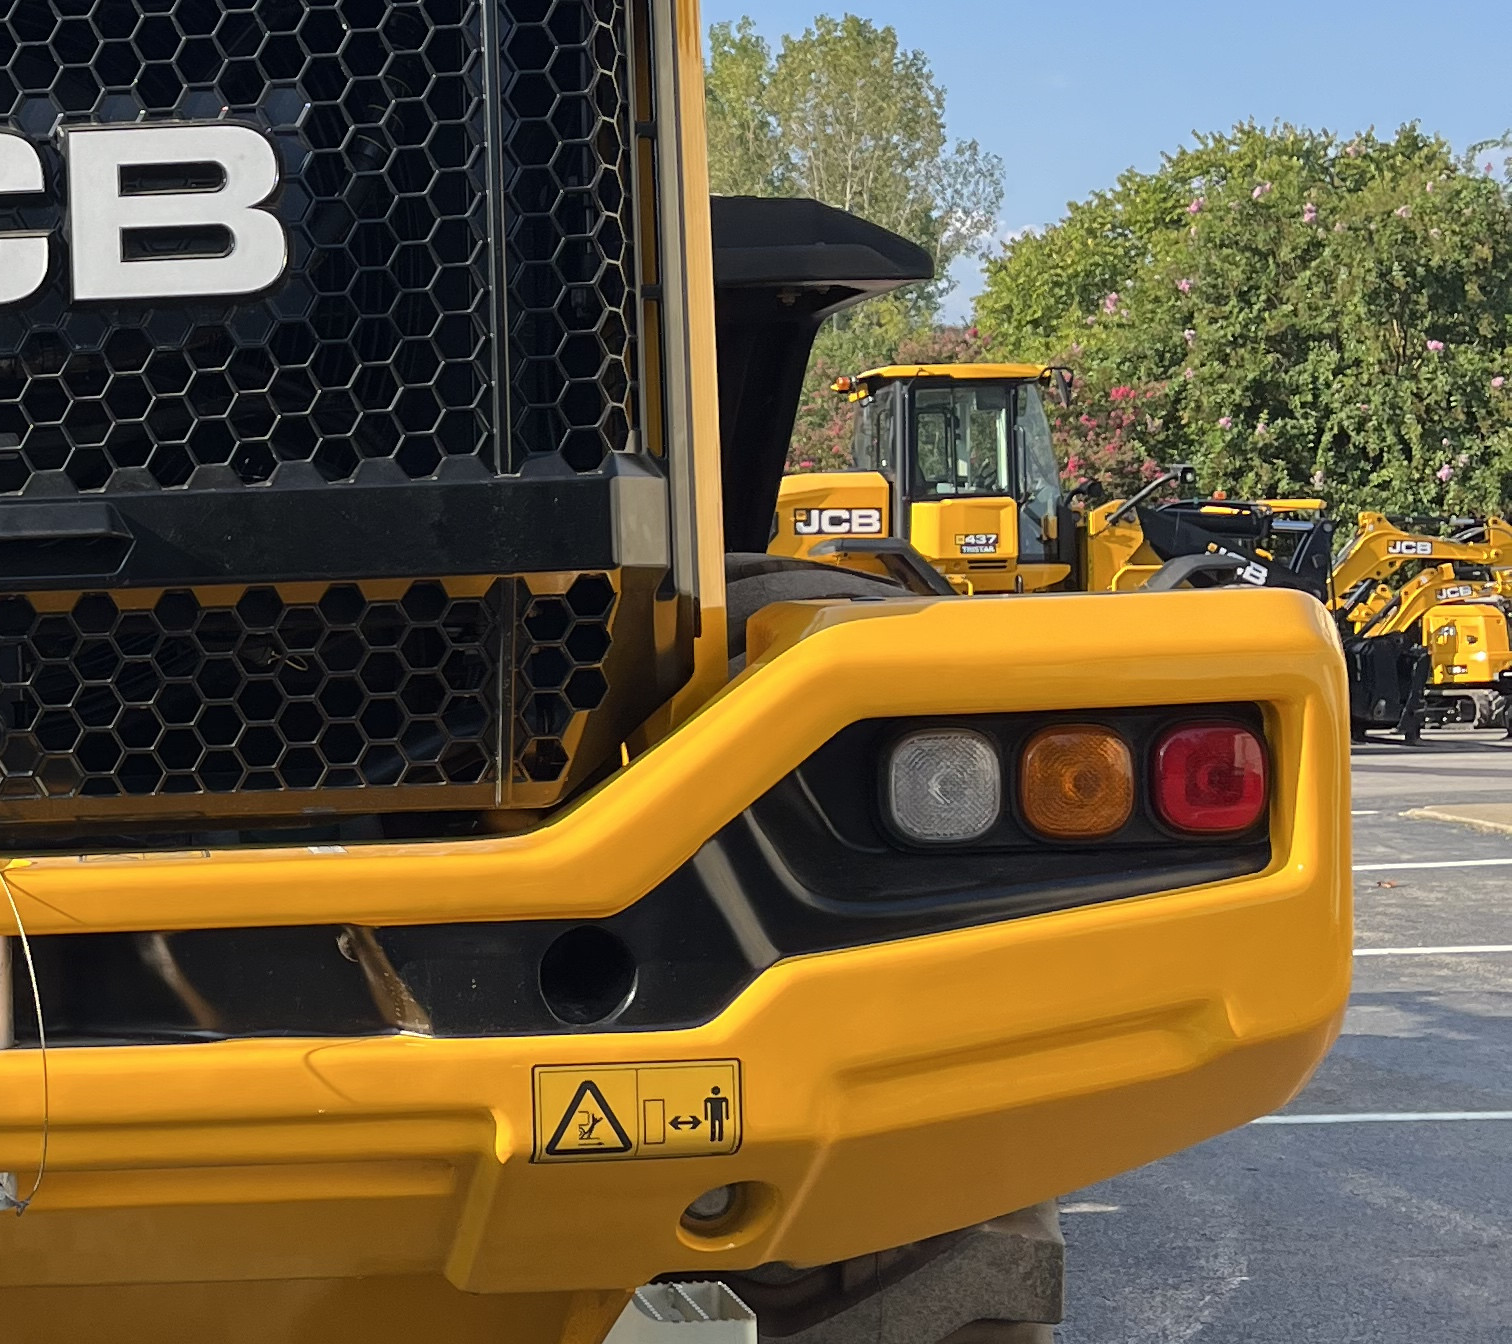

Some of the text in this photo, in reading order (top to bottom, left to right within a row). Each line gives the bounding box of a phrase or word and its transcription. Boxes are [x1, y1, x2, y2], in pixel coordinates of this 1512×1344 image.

[795, 509, 881, 534] JCB
[965, 534, 998, 545] 437
[1387, 541, 1432, 555] JCB
[1436, 585, 1472, 600] JCB
